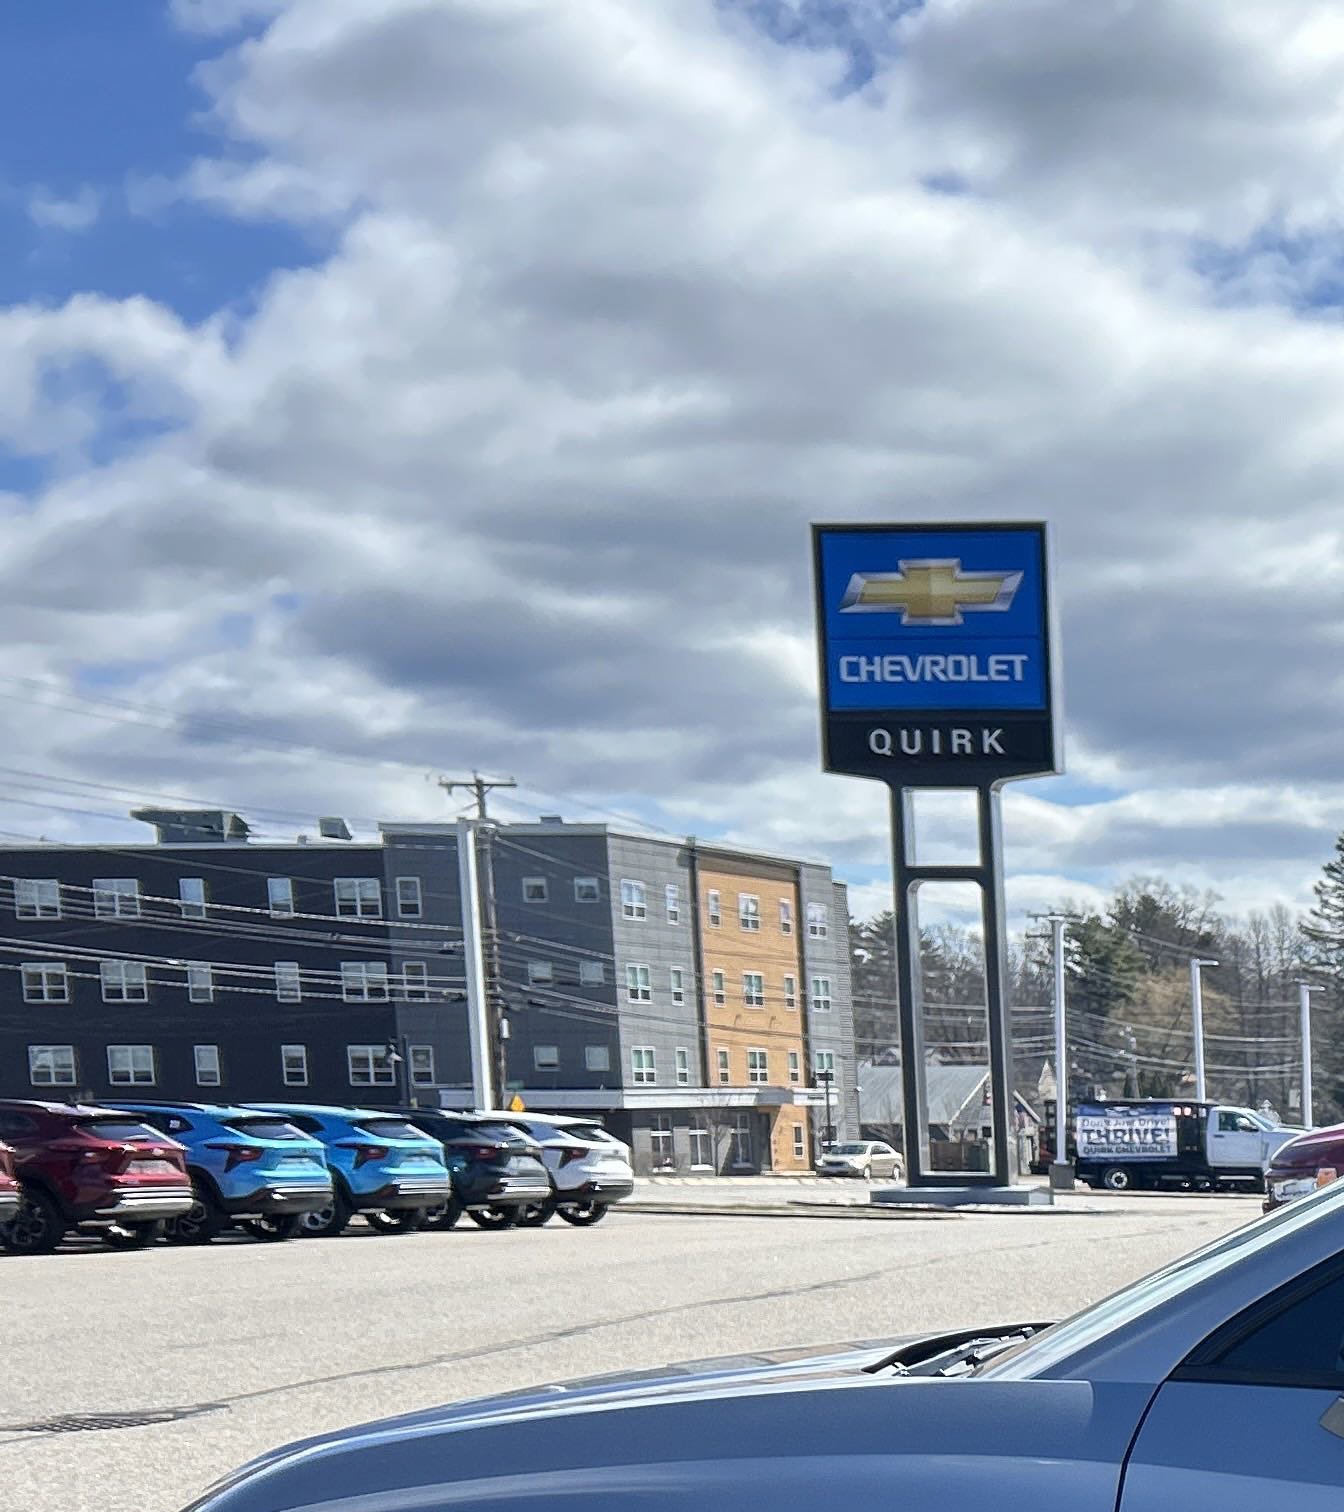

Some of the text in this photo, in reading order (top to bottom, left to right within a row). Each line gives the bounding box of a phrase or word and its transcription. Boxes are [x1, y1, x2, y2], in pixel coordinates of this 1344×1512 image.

[839, 654, 1028, 682] CHEVROLET
[869, 727, 1005, 757] QUIRK
[1082, 1128, 1170, 1145] THRIVE!
